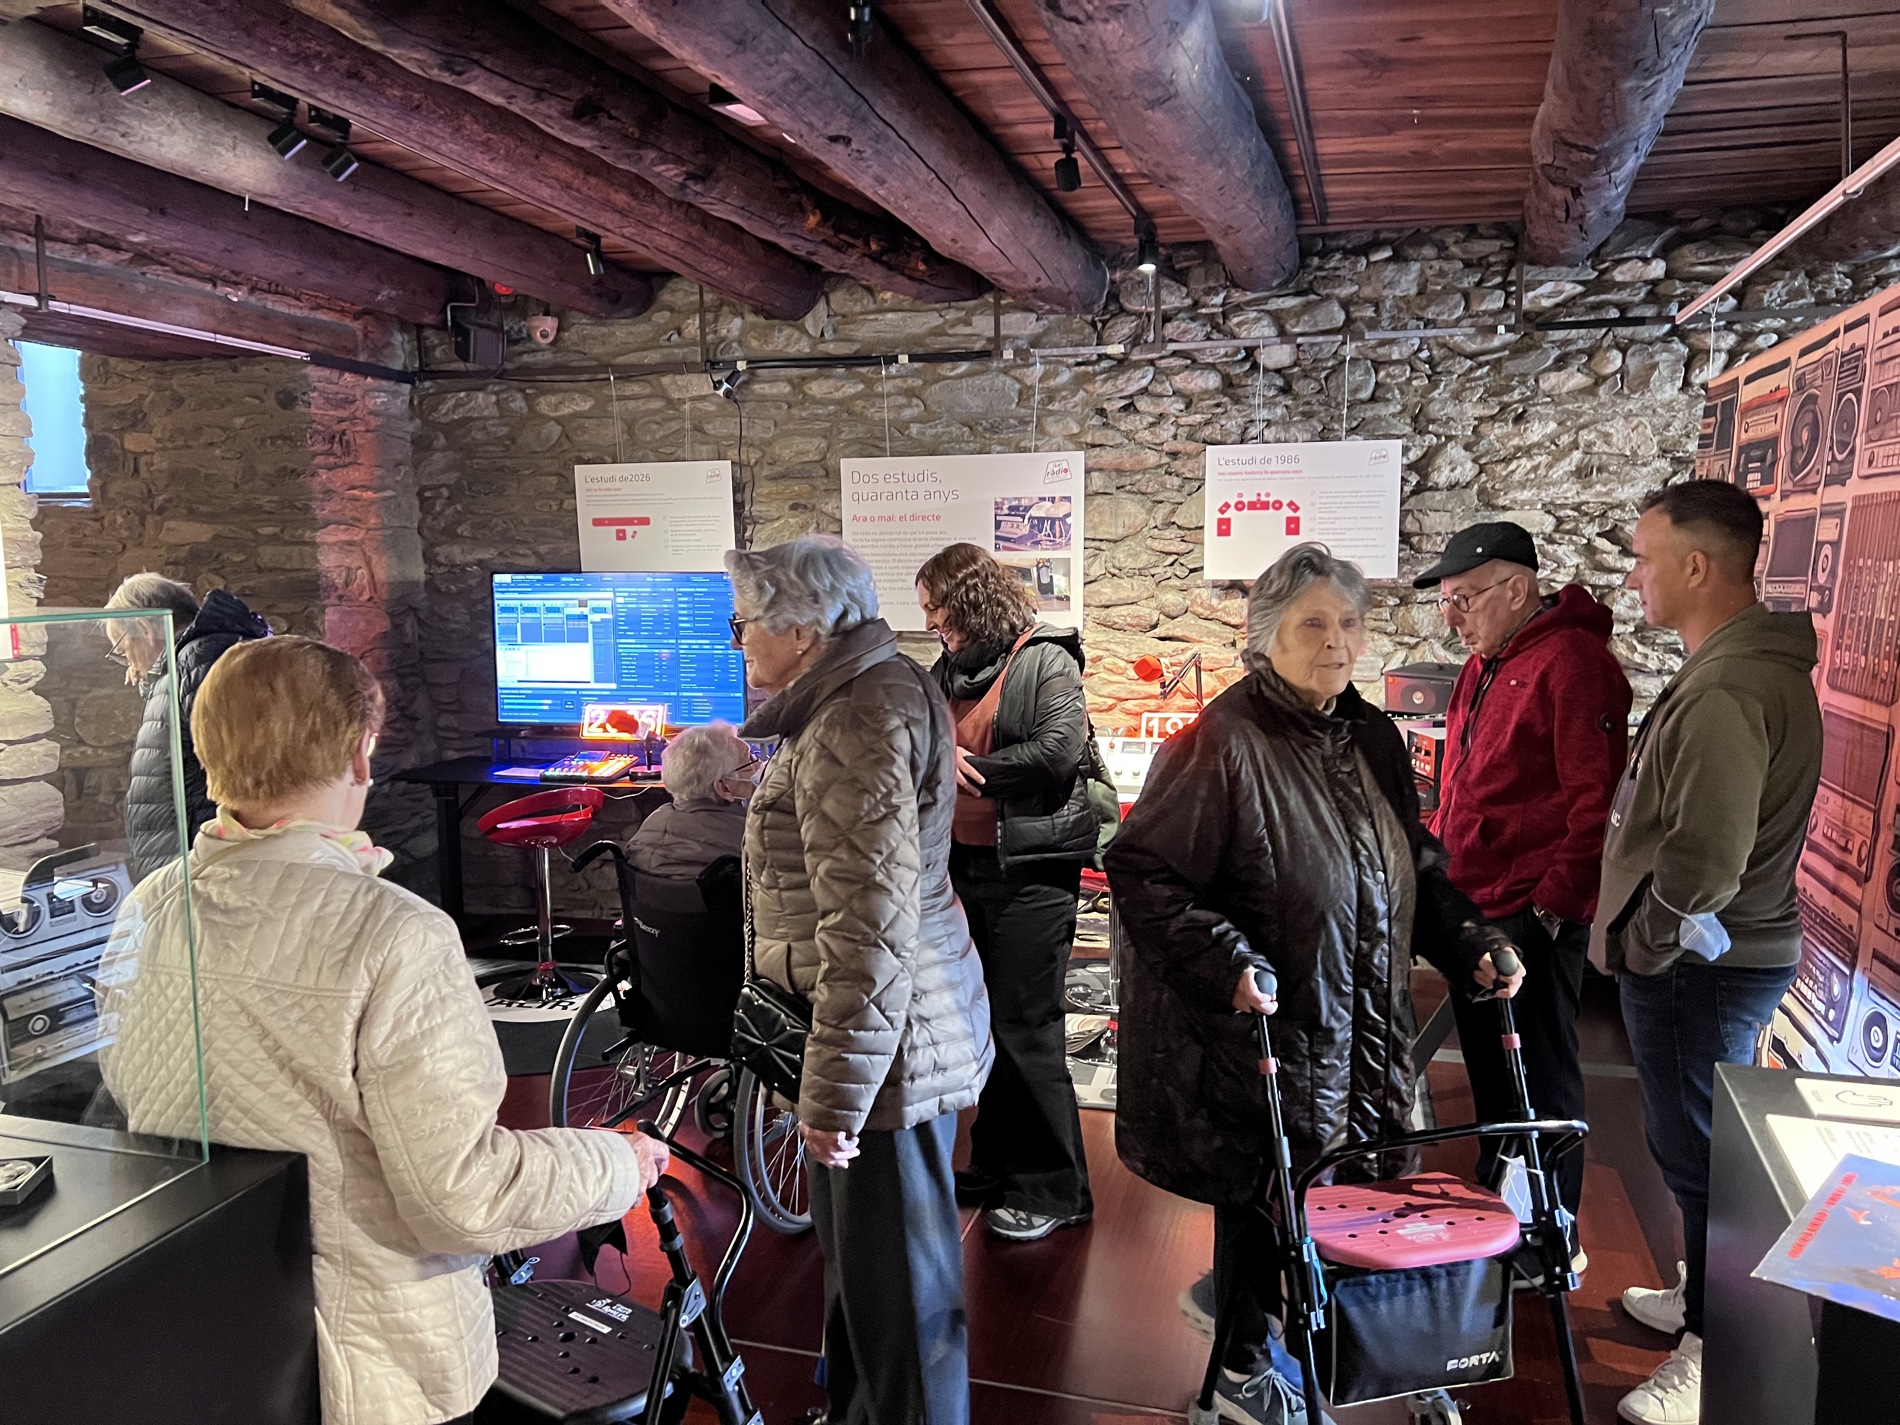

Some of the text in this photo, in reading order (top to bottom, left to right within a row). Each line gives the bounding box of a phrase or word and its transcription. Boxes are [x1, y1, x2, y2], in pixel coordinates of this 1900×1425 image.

[1217, 454, 1301, 466] L'estudi de 1986
[584, 475, 617, 483] L'estudi
[851, 469, 942, 484] Dos estudis,
[851, 488, 960, 505] quaranta anys
[851, 514, 868, 522] Ara
[877, 514, 897, 522] mai:
[898, 513, 907, 522] el
[908, 513, 942, 522] directe
[1148, 717, 1196, 739] 19
[1446, 1351, 1500, 1371] FORTA
